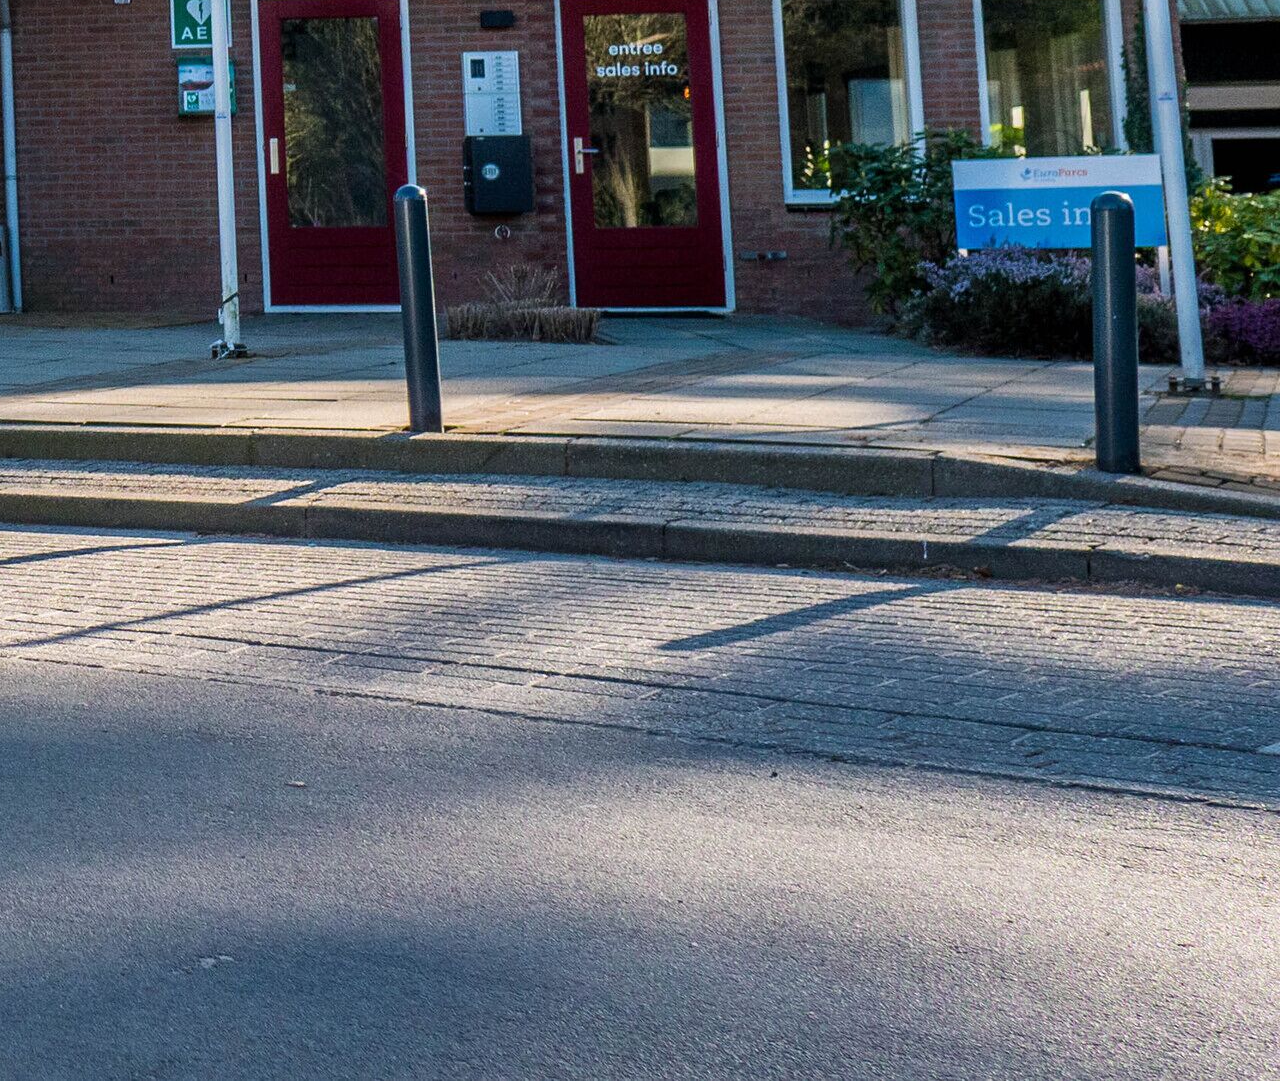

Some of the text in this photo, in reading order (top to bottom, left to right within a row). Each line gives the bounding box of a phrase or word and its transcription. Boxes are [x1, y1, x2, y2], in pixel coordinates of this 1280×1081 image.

[182, 27, 208, 40] AE
[608, 42, 663, 56] entree
[596, 60, 678, 77] sales info
[1033, 168, 1088, 179] EuroParcs
[968, 200, 1092, 228] Sales in
